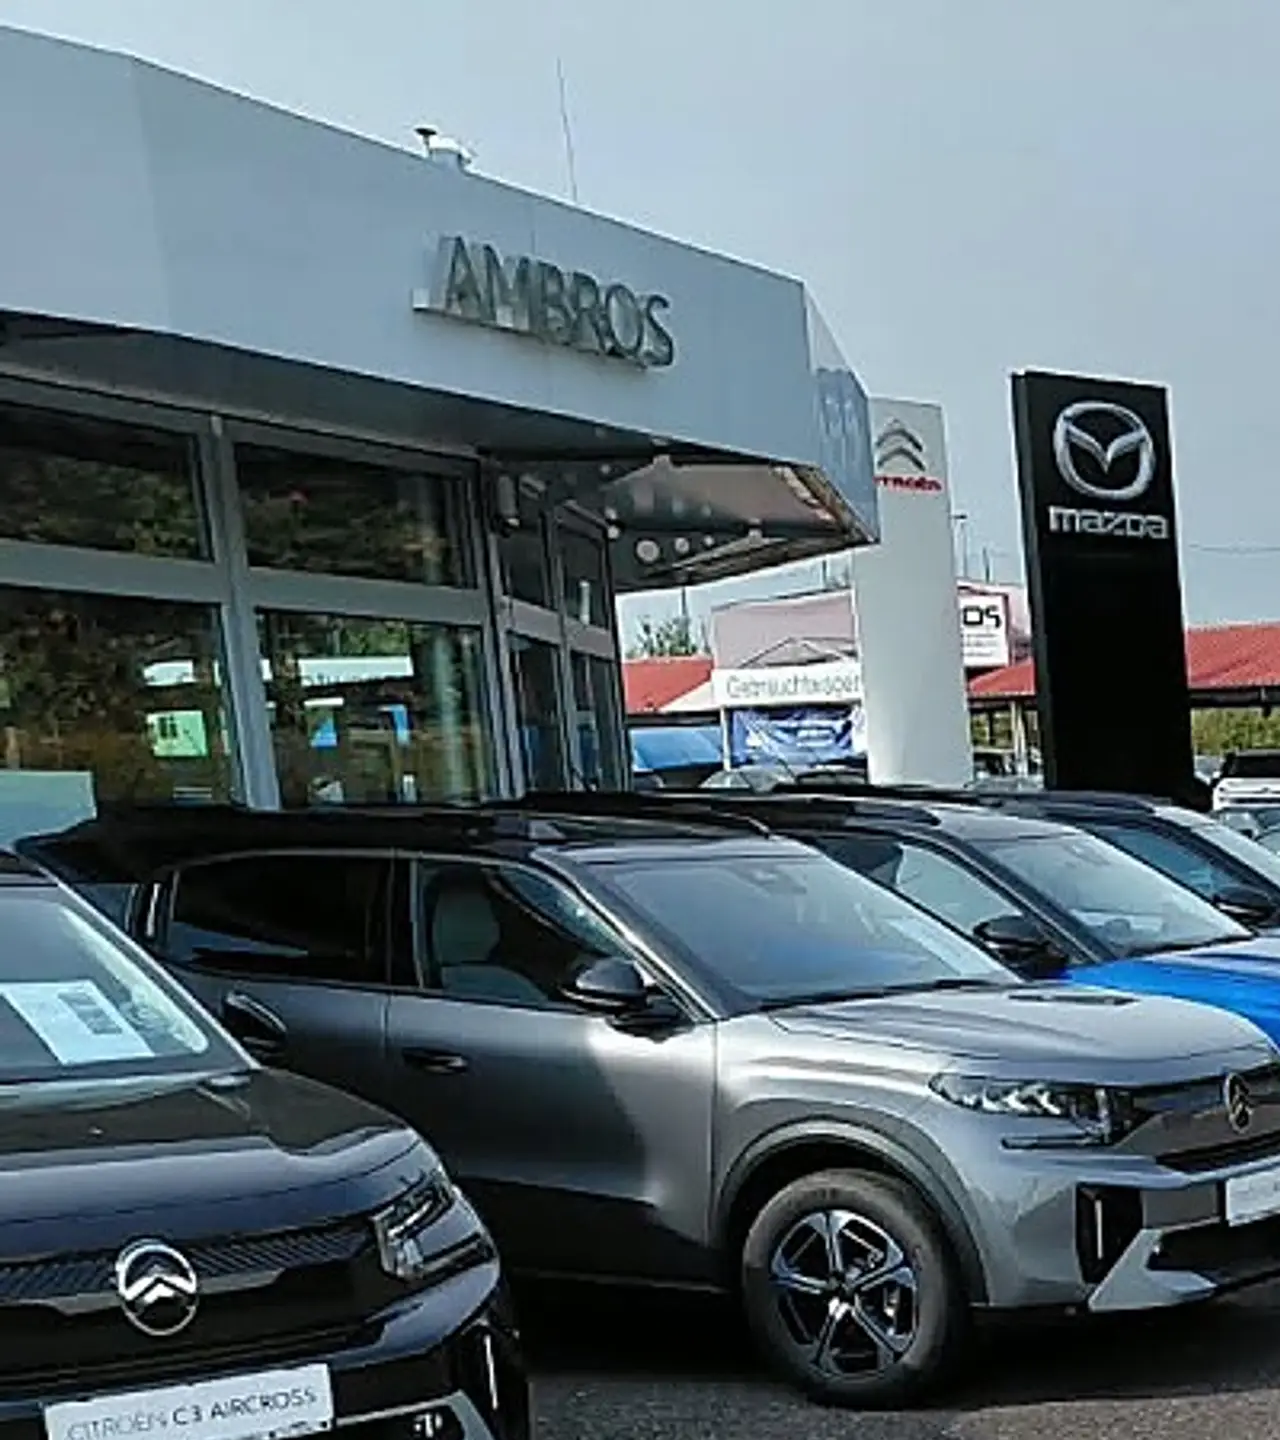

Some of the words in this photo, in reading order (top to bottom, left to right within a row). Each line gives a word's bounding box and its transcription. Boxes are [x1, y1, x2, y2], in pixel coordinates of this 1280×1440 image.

[440, 234, 676, 369] AMBROS
[172, 1406, 203, 1427] C3
[210, 1385, 319, 1422] AIRCROSS
